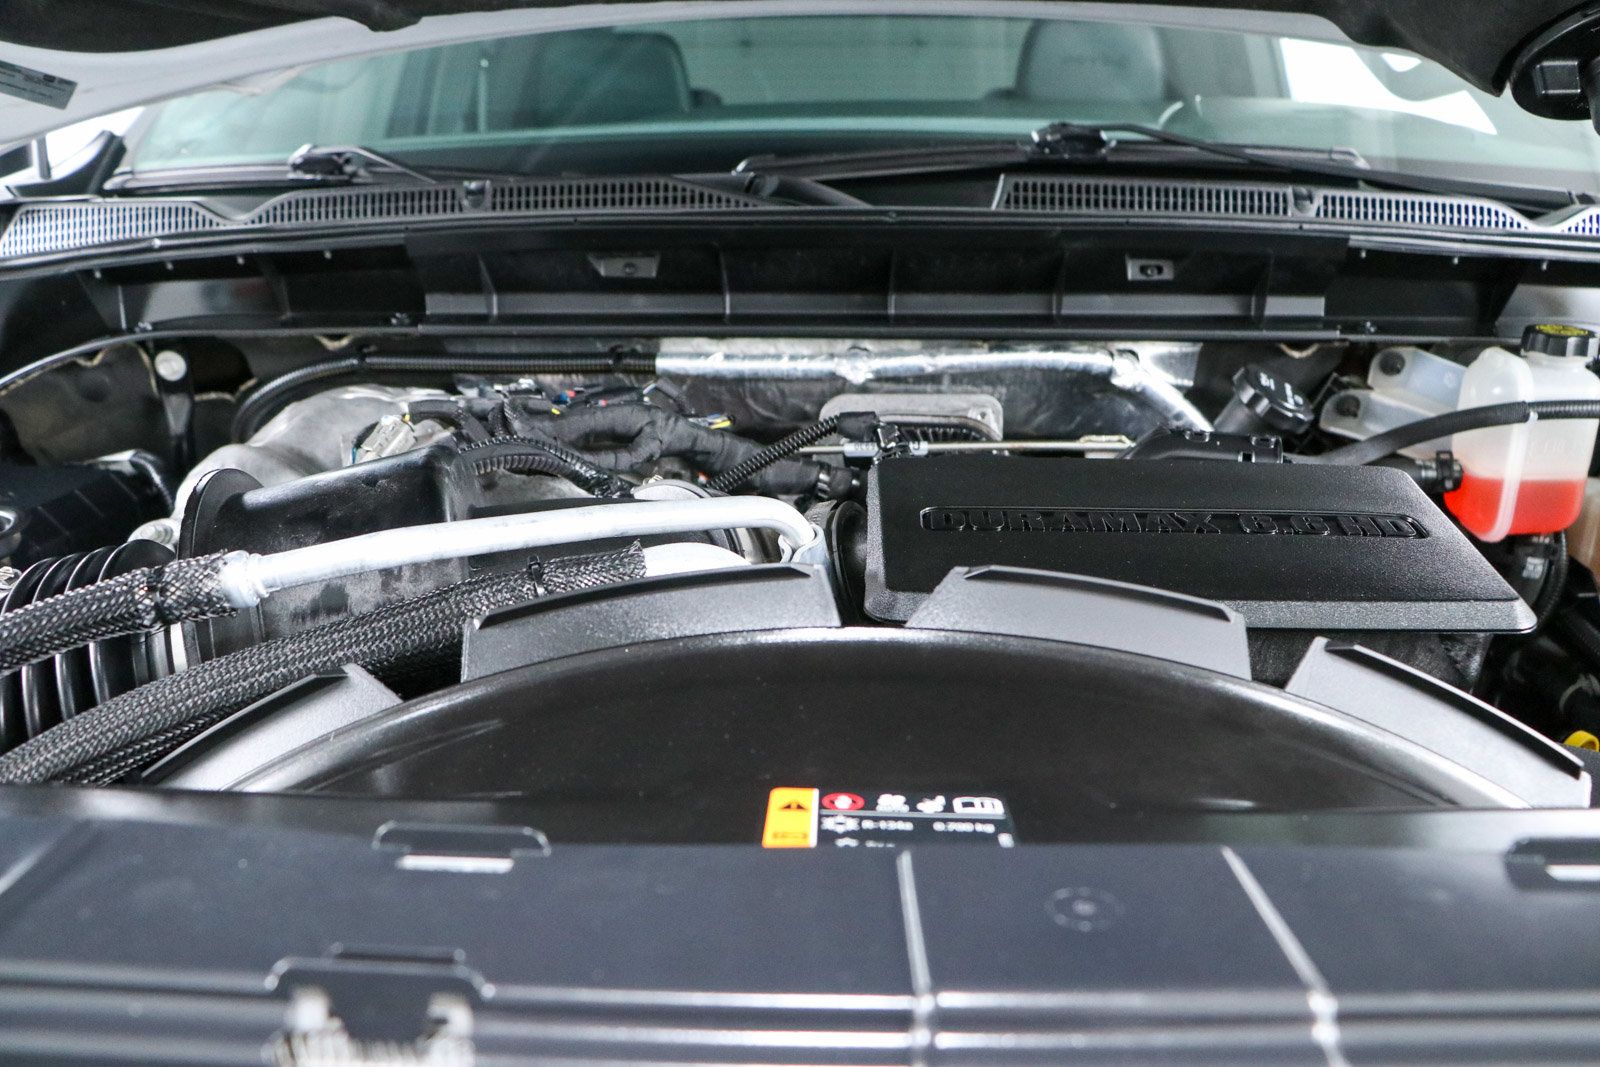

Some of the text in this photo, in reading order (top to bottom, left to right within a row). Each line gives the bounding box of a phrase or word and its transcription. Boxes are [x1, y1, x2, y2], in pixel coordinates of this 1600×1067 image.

[927, 509, 1419, 537] DURAMAX 6.6 HD
